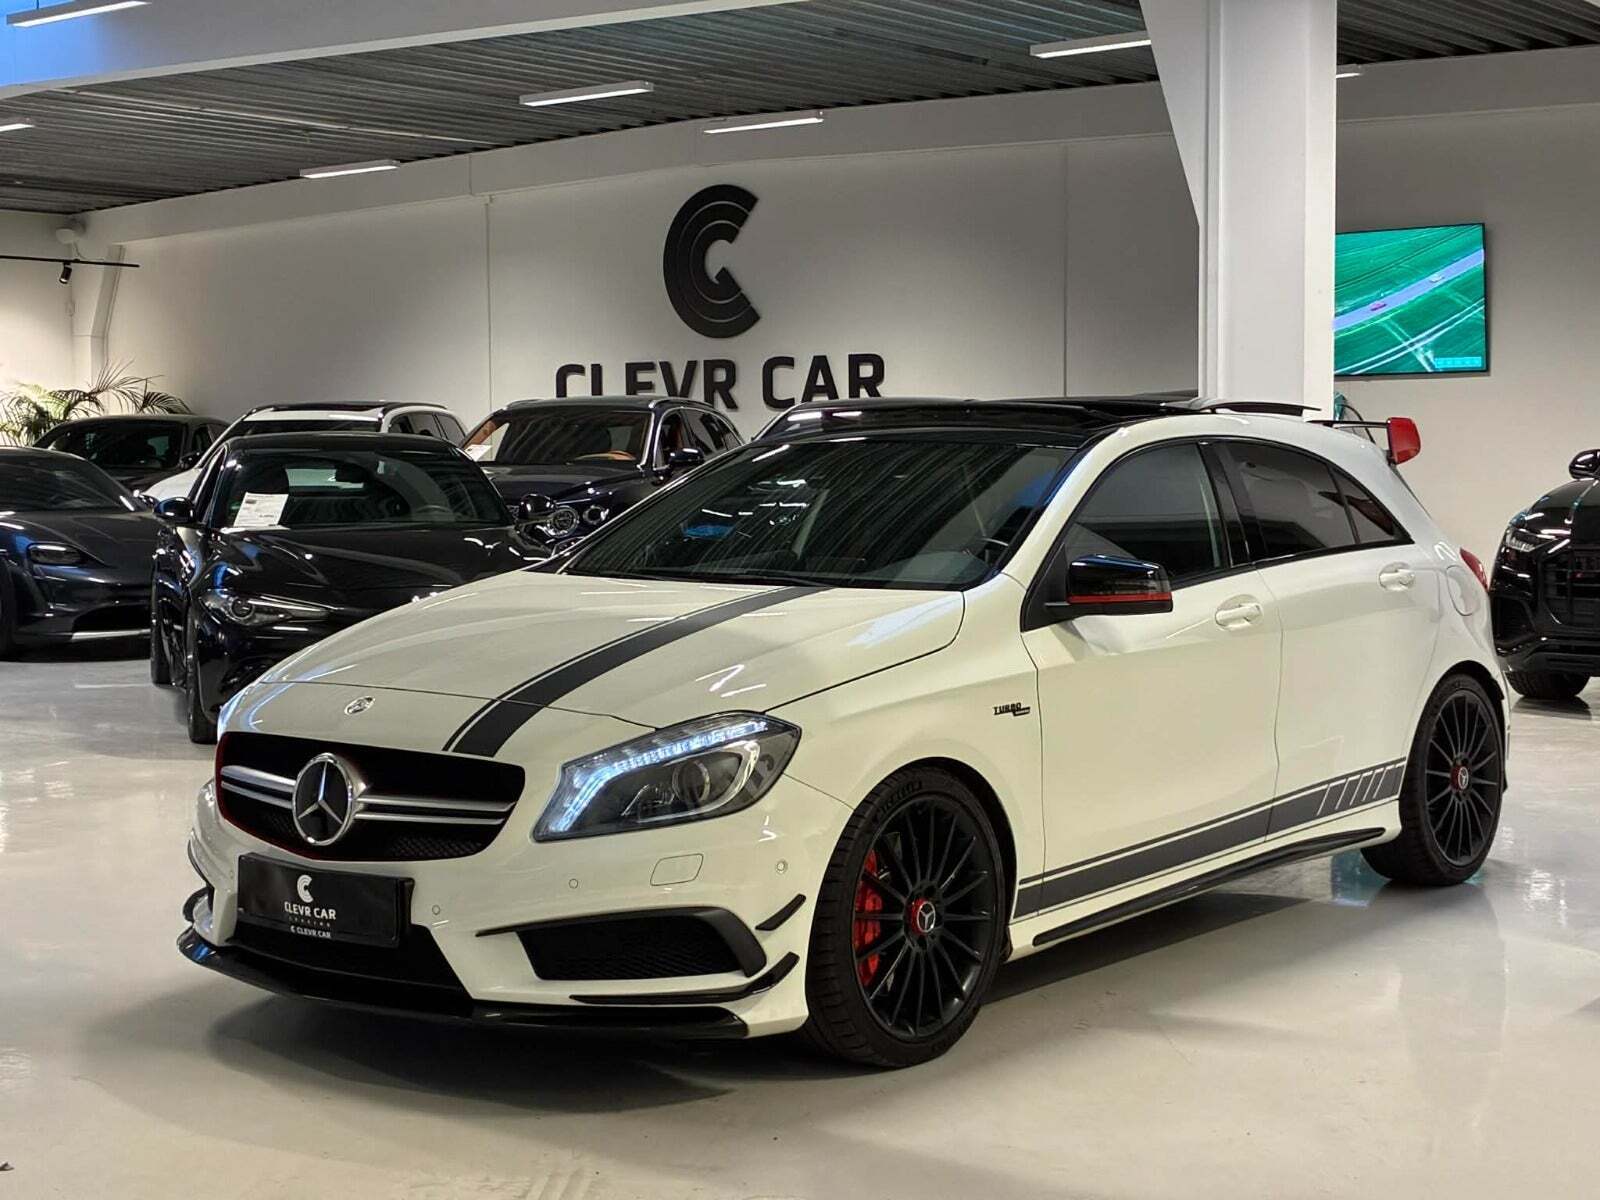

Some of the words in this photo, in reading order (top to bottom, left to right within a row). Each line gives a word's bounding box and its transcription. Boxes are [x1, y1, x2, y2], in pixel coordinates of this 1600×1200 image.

[762, 353, 885, 409] CAR
[284, 901, 312, 917] CLEVR
[313, 908, 337, 920] CAR
